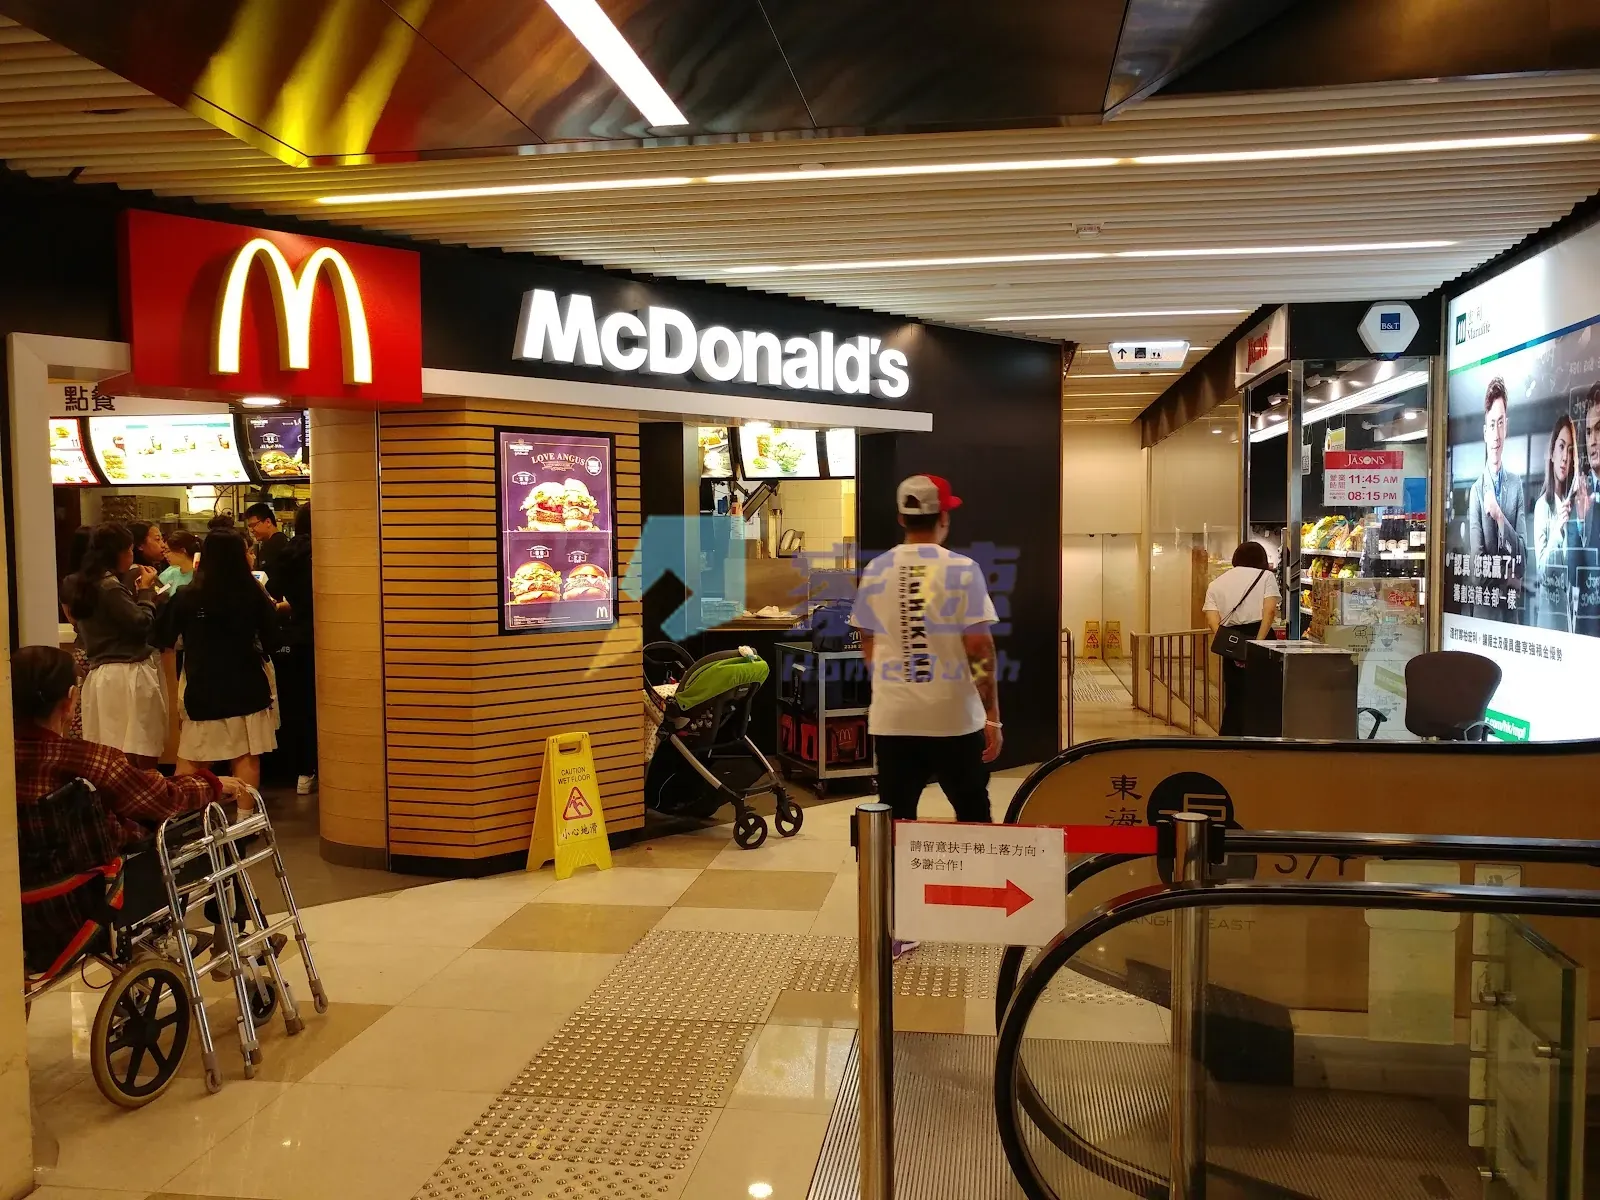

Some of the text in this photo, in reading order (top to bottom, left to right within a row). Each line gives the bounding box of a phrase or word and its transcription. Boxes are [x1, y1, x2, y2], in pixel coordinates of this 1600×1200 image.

[1381, 322, 1400, 330] B&T
[514, 288, 910, 399] McDonald's
[531, 453, 555, 464] LOVE
[556, 453, 585, 466] ANGUS
[1348, 474, 1398, 484] 11:45 AM
[1347, 491, 1381, 501] 08:15
[1382, 492, 1397, 500] PM
[560, 766, 586, 777] CAUTION
[557, 773, 591, 785] WET FLOOR
[562, 822, 598, 840] 小心地滑
